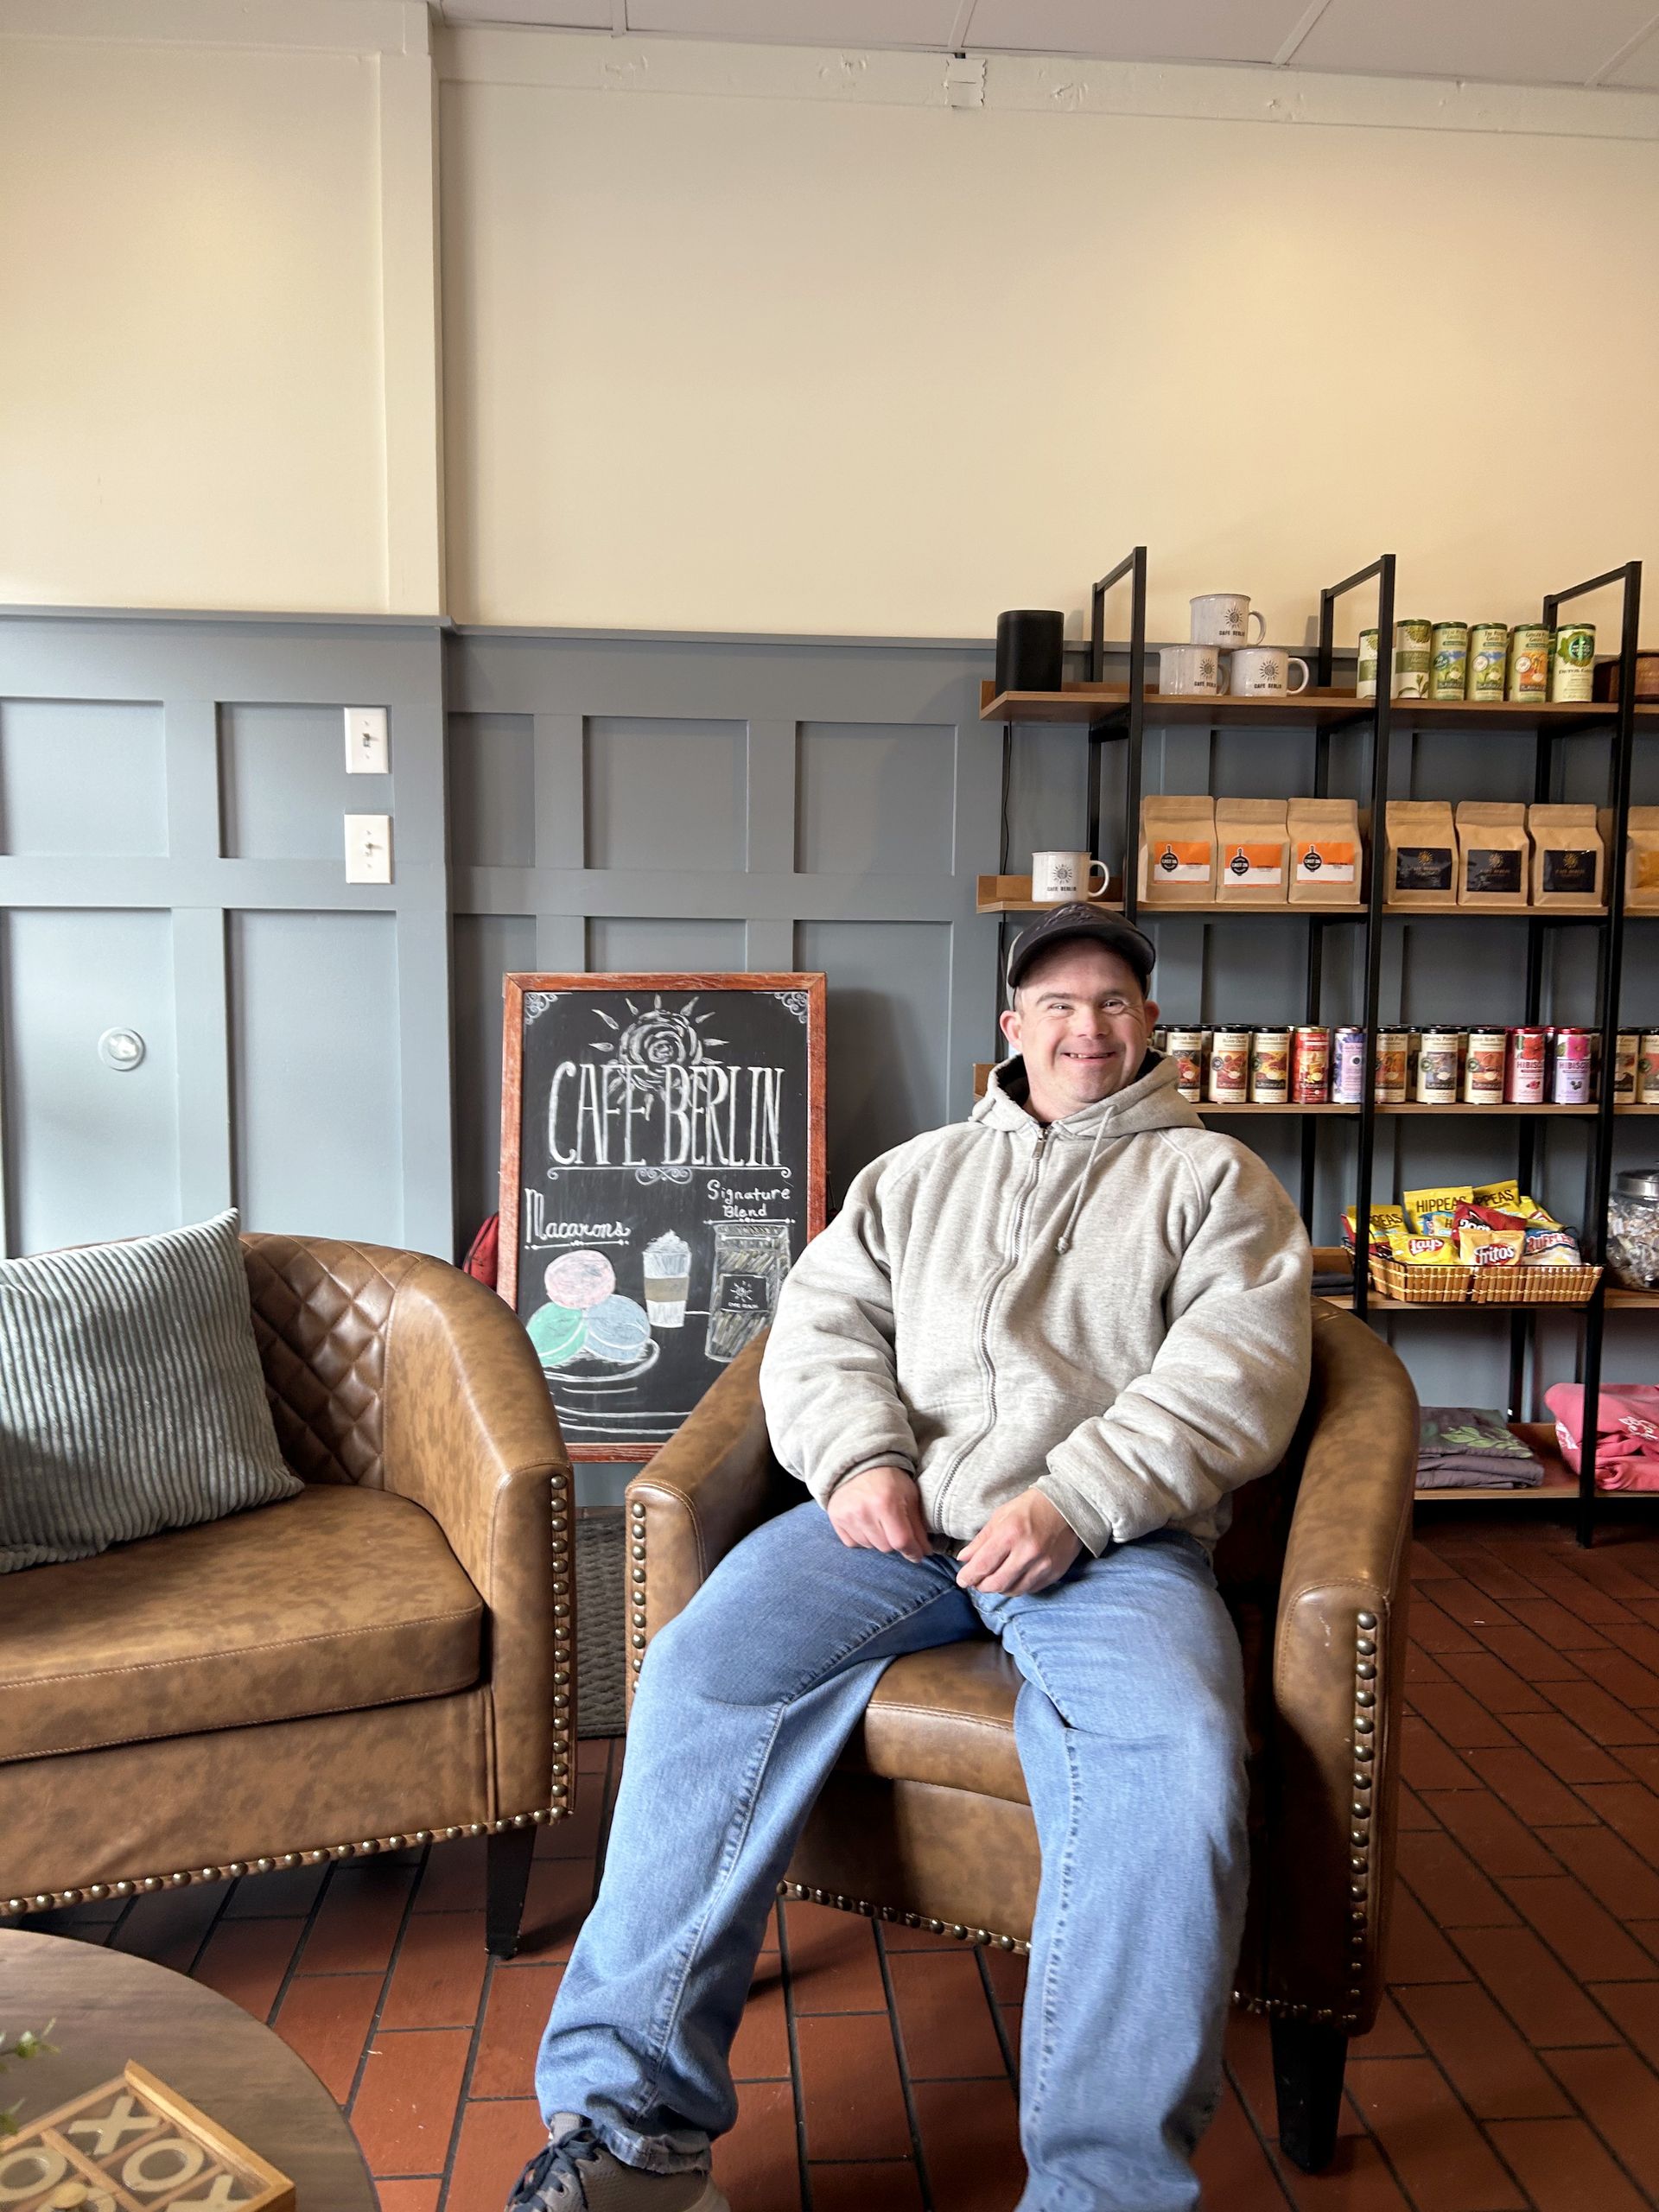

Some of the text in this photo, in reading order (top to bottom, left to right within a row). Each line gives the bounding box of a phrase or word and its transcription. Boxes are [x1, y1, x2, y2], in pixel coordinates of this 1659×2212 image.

[548, 1061, 785, 1166] CAFE BERLIN
[707, 1179, 791, 1205] Signature
[722, 1205, 768, 1219] Blend
[524, 1187, 631, 1243] Macarons
